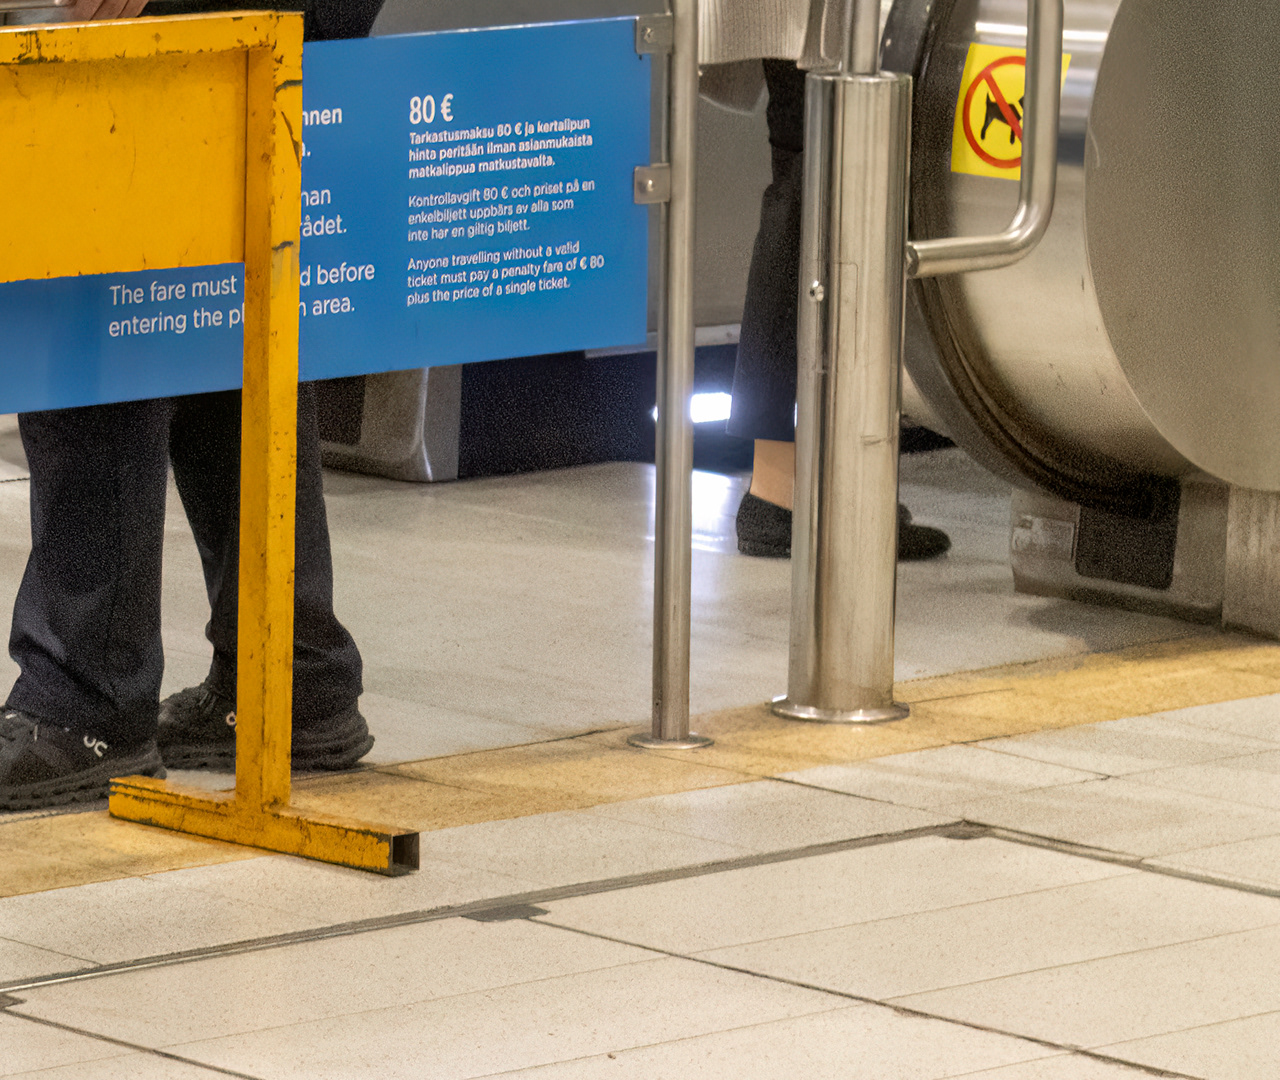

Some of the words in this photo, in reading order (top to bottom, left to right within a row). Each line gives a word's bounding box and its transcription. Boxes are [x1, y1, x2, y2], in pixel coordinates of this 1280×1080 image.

[409, 94, 436, 125] 80
[440, 93, 454, 122] €
[409, 127, 494, 145] Tarkastusmaksu
[497, 124, 511, 136] 80
[514, 122, 523, 135] €
[524, 122, 534, 137] ja
[537, 118, 590, 133] kertalipun
[408, 148, 437, 162] hinta
[439, 143, 484, 161] peritään
[487, 141, 516, 155] ilman
[518, 134, 593, 152] asianmukaista
[408, 162, 476, 179] matkalippua
[478, 154, 555, 173] matkustavalta.
[408, 189, 481, 207] Kontrollavgift
[483, 187, 498, 201] 80
[501, 186, 509, 199] €
[511, 182, 531, 198] och
[533, 181, 563, 197] priset
[566, 178, 579, 195] på
[582, 179, 595, 191] en
[408, 209, 467, 225] enkelbiljett
[469, 203, 513, 220] uppbärs
[516, 203, 528, 215] av
[531, 200, 549, 212] alla
[552, 198, 574, 211] som
[408, 228, 428, 242] inte
[431, 226, 449, 240] har
[451, 226, 465, 238] en
[467, 222, 495, 239] giltig
[497, 219, 530, 234] biljett.
[407, 258, 449, 272] Anyone
[451, 251, 501, 267] travelling
[503, 245, 543, 261] without
[545, 247, 552, 257] a
[555, 240, 580, 256] valid
[407, 274, 438, 288] ticket
[441, 270, 467, 285] must
[469, 270, 489, 283] pay
[492, 269, 499, 279] a
[501, 263, 540, 280] penalty
[543, 260, 563, 273] fare
[565, 258, 577, 271] of
[579, 257, 587, 270] €
[590, 254, 605, 269] 80
[109, 284, 144, 306] The
[150, 280, 186, 302] fare
[192, 275, 237, 298] must
[317, 261, 375, 285] before
[407, 291, 430, 307] plus
[432, 289, 450, 302] the
[452, 287, 480, 303] price
[482, 283, 493, 297] of
[496, 285, 503, 296] a
[505, 279, 536, 296] single
[538, 276, 571, 291] ticket.
[108, 312, 187, 337] entering
[193, 306, 223, 329] the
[312, 296, 355, 317] area.
